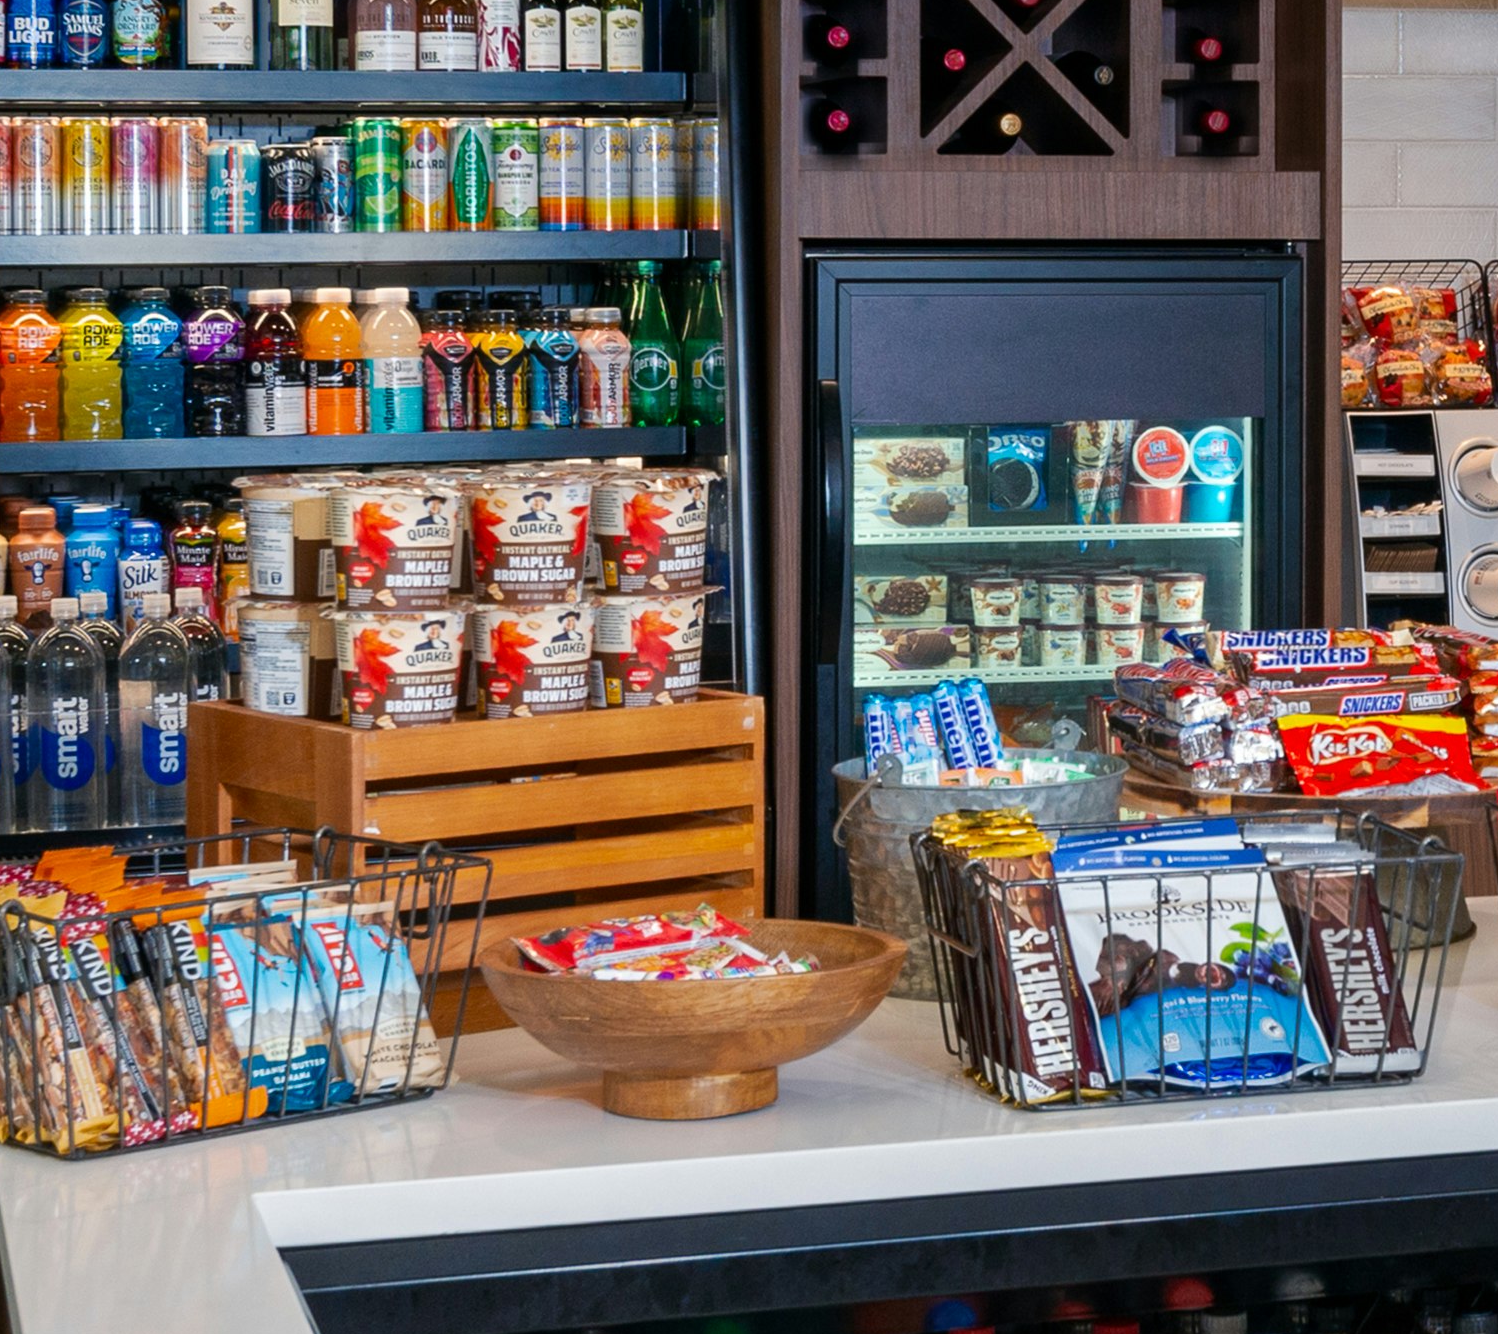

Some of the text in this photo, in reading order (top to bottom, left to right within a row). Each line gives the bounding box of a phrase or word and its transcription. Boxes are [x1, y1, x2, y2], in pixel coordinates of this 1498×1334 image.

[13, 17, 50, 31] BUD
[9, 30, 54, 44] LIGHT
[465, 143, 477, 217] HORNITOS
[133, 322, 178, 335] POWER
[188, 322, 234, 335] POWER
[407, 527, 451, 542] QUAKER
[509, 521, 564, 537] QUAKER
[17, 549, 59, 562] fairlife
[68, 546, 107, 559] fairlife
[176, 545, 211, 555] Minute
[181, 553, 206, 564] Maid
[508, 555, 565, 568] MAPLE &
[122, 565, 158, 589] Silk
[494, 567, 576, 582] BROWN SUGAR
[1227, 631, 1329, 648] SNICKERS
[405, 650, 454, 667] QUAKER
[523, 688, 568, 703] BROWN
[1342, 695, 1402, 713] SNICKERS
[79, 697, 90, 734] water
[58, 696, 78, 779] smart
[159, 692, 179, 774] smart
[1096, 899, 1253, 925] BROOKSIDE
[168, 921, 201, 981] KIND
[72, 937, 117, 997] KIND
[1320, 927, 1388, 1050] HERSHEY'S
[1009, 929, 1080, 1076] HERSHEY'S
